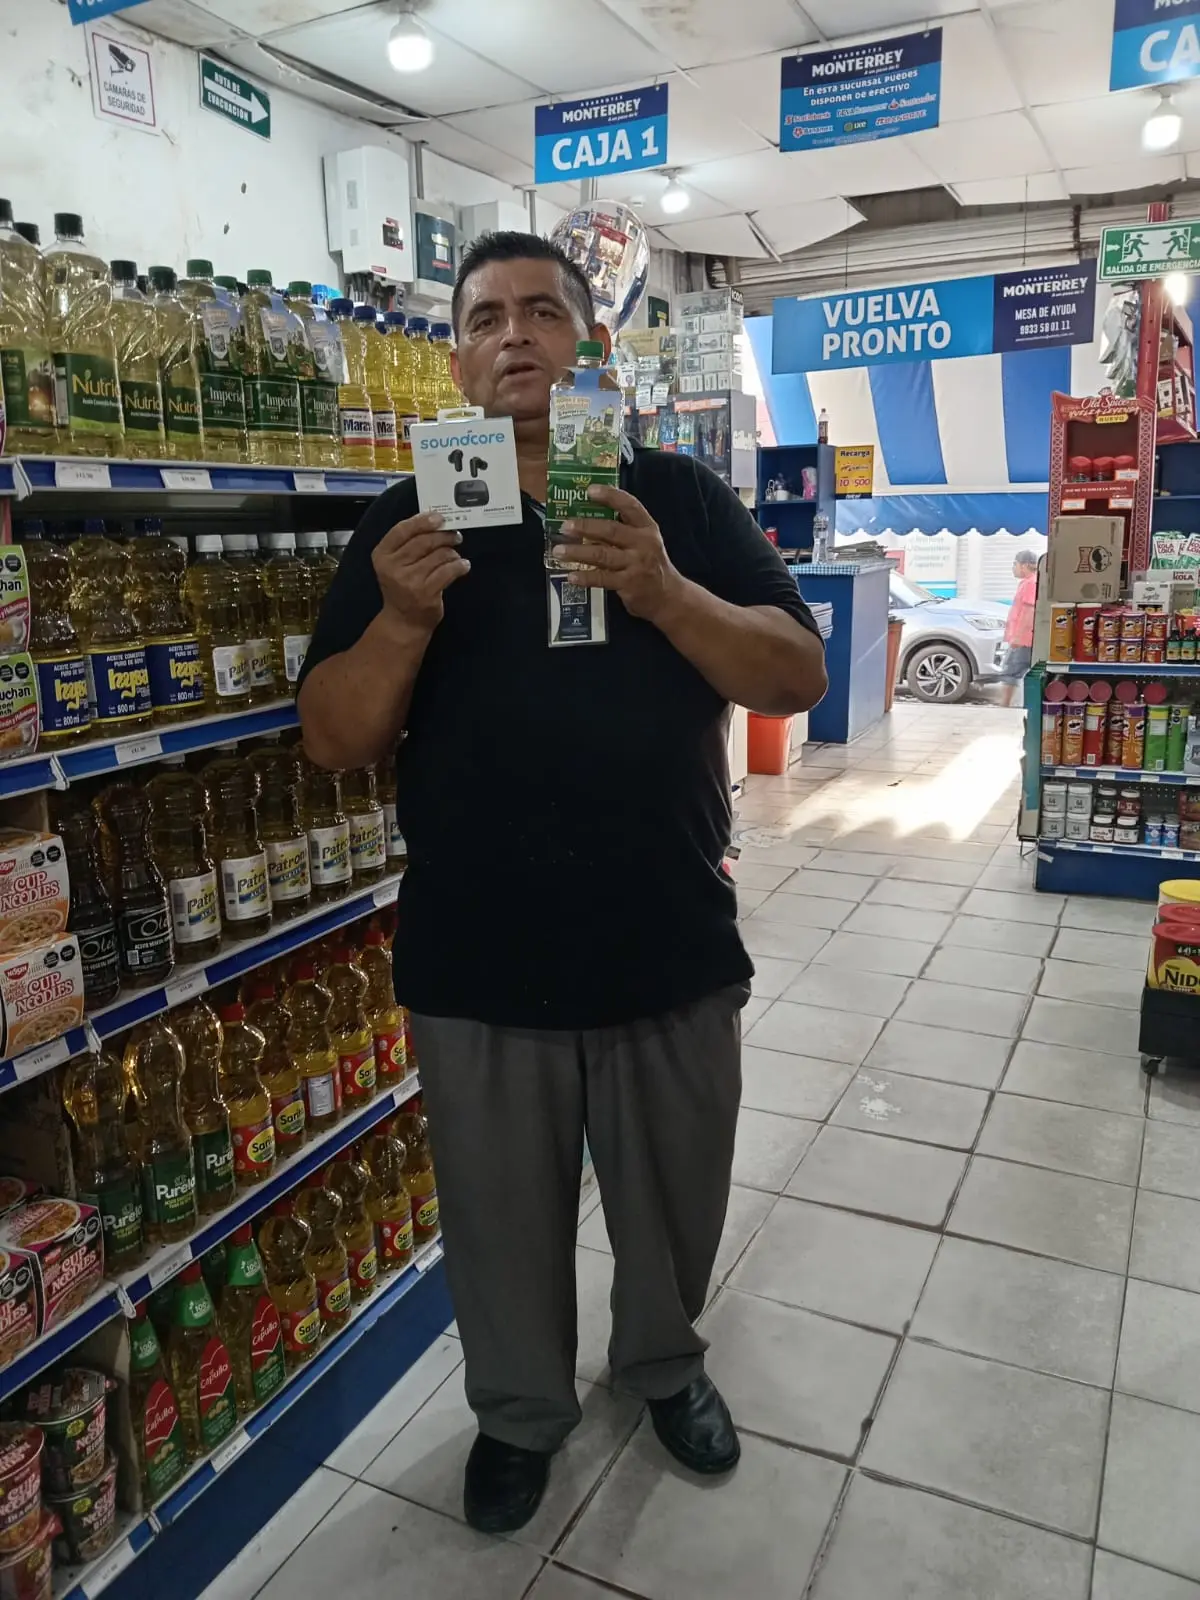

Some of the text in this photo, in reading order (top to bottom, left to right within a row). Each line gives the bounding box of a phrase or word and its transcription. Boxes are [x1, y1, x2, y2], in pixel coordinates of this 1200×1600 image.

[811, 48, 904, 77] MONTERREY
[214, 71, 241, 94] RUTA DE
[108, 96, 145, 116] SEGURIDAD
[137, 92, 146, 103] DE
[562, 98, 641, 123] MONTERREY
[552, 125, 659, 171] CAJA 1
[1105, 262, 1135, 274] SALIDA
[1136, 261, 1148, 273] DE
[1003, 276, 1088, 298] MONTERREY
[822, 288, 941, 329] VUELVA
[1015, 303, 1077, 321] MESA DE AYUDA
[1051, 321, 1060, 332] 01
[1061, 320, 1071, 330] 11
[822, 320, 952, 361] PRONTO
[1081, 396, 1100, 410] Old
[420, 431, 505, 450] soundcore
[840, 450, 870, 458] Recarga
[839, 478, 871, 487] 10 500
[177, 690, 194, 701] 800 ml
[117, 701, 135, 714] 800 ml
[63, 713, 80, 726] 800 ml
[14, 871, 47, 892] CUP
[1, 881, 60, 913] NOODLES
[28, 970, 61, 996] CUP
[16, 978, 73, 1015] NOODLES
[61, 1245, 87, 1274] CUP
[51, 1249, 97, 1296] NOODLES
[252, 1321, 278, 1347] Capullo
[200, 1363, 229, 1389] Capullo
[145, 1405, 174, 1434] Capullo
